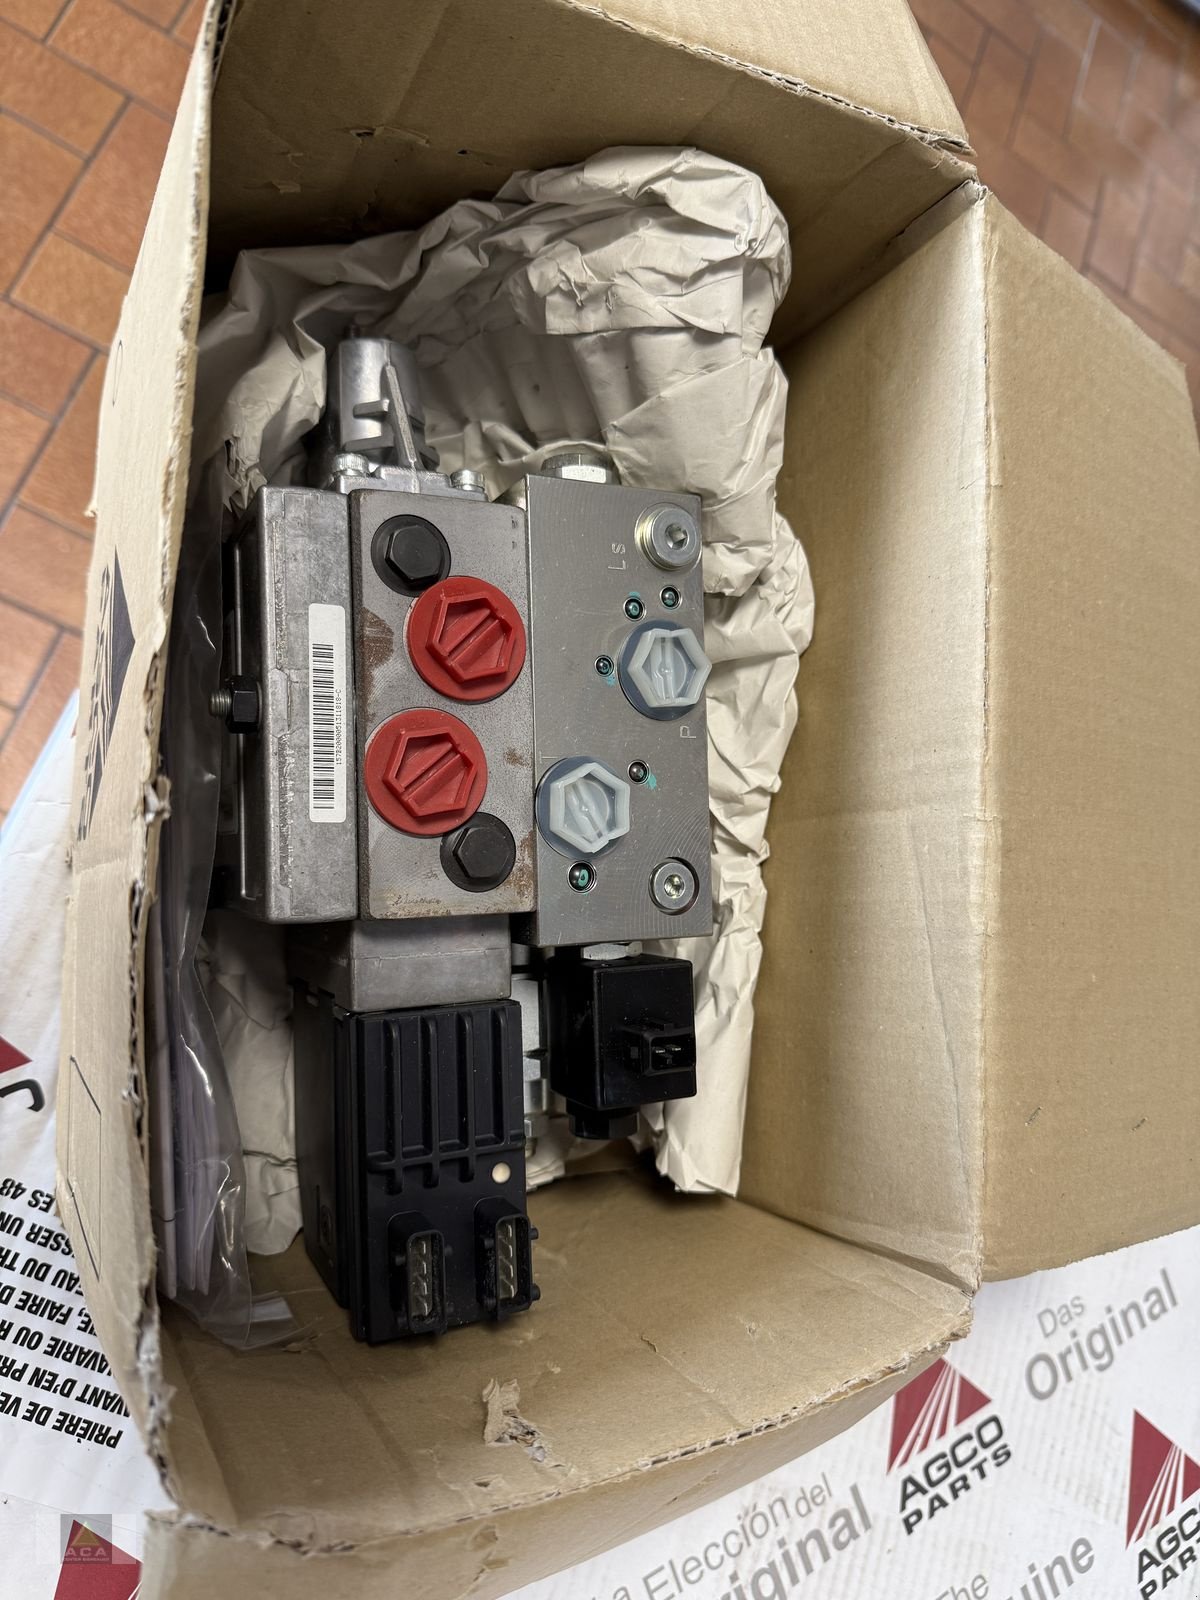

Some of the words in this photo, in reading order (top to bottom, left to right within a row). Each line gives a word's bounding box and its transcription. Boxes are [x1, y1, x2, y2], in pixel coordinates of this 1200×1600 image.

[679, 725, 697, 739] P
[0, 1178, 27, 1200] 48
[0, 1211, 24, 1237] UN
[20, 1257, 53, 1282] DU
[0, 1282, 17, 1306] D
[14, 1290, 74, 1326] FAIRE
[1036, 1294, 1086, 1339] Das
[12, 1326, 44, 1350] OU
[1025, 1266, 1179, 1402] Original
[0, 1355, 29, 1382] PR
[0, 1390, 22, 1417] VE
[21, 1401, 53, 1427] DE
[51, 1411, 124, 1449] PRIÈRE
[899, 1414, 1004, 1513] AGCO
[902, 1443, 1012, 1536] PARTS
[642, 1495, 790, 1600] Elección
[794, 1472, 833, 1518] del
[1137, 1502, 1200, 1584] AGC
[1140, 1536, 1200, 1600] PAR
